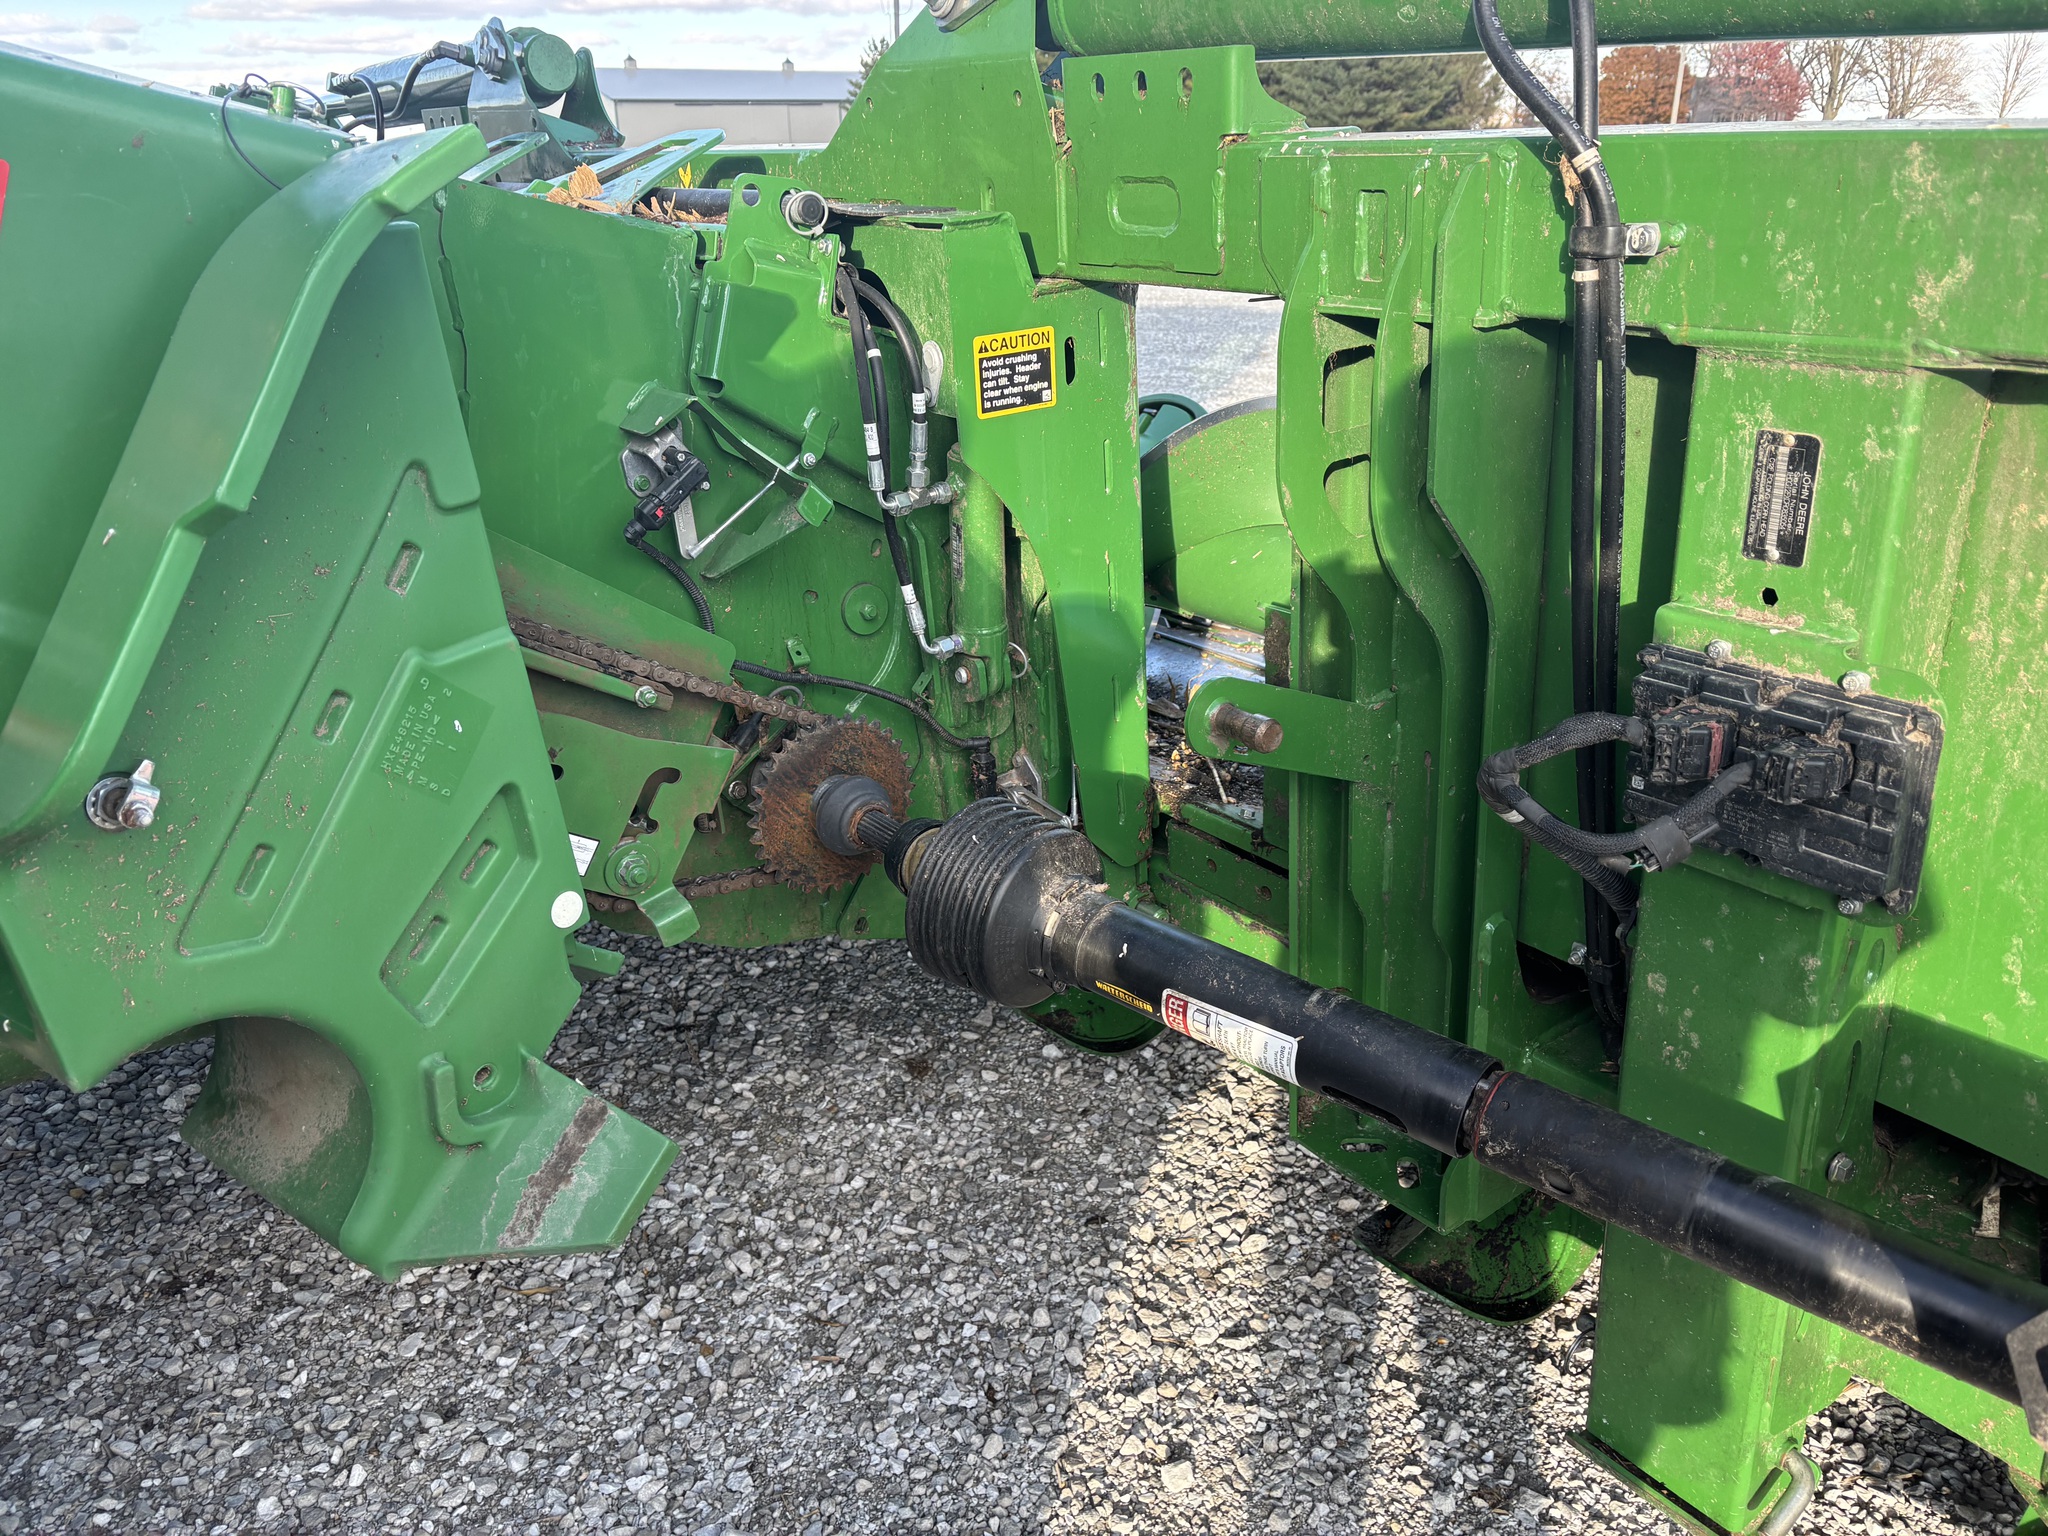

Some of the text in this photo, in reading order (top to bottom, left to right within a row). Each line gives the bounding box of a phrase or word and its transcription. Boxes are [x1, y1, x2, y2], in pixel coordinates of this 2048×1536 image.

[1492, 16, 1501, 28] DN
[1499, 31, 1507, 42] 10
[989, 330, 1050, 352] CAUTION
[982, 353, 1037, 368] Avoid crushing
[982, 362, 1041, 379] injuries. Header
[983, 374, 1030, 389] can tilt. Stay
[983, 381, 1049, 398] clear when engine
[984, 396, 1023, 408] is running.
[1765, 473, 1774, 499] FOLDING
[1791, 471, 1801, 496] Serial
[1795, 471, 1812, 536] JOHN DEERE
[381, 705, 418, 770] HXE48215
[394, 695, 436, 776] MADE IN USA
[417, 775, 428, 786] M
[429, 782, 438, 791] S
[441, 788, 451, 797] D
[1168, 998, 1185, 1034] NGER
